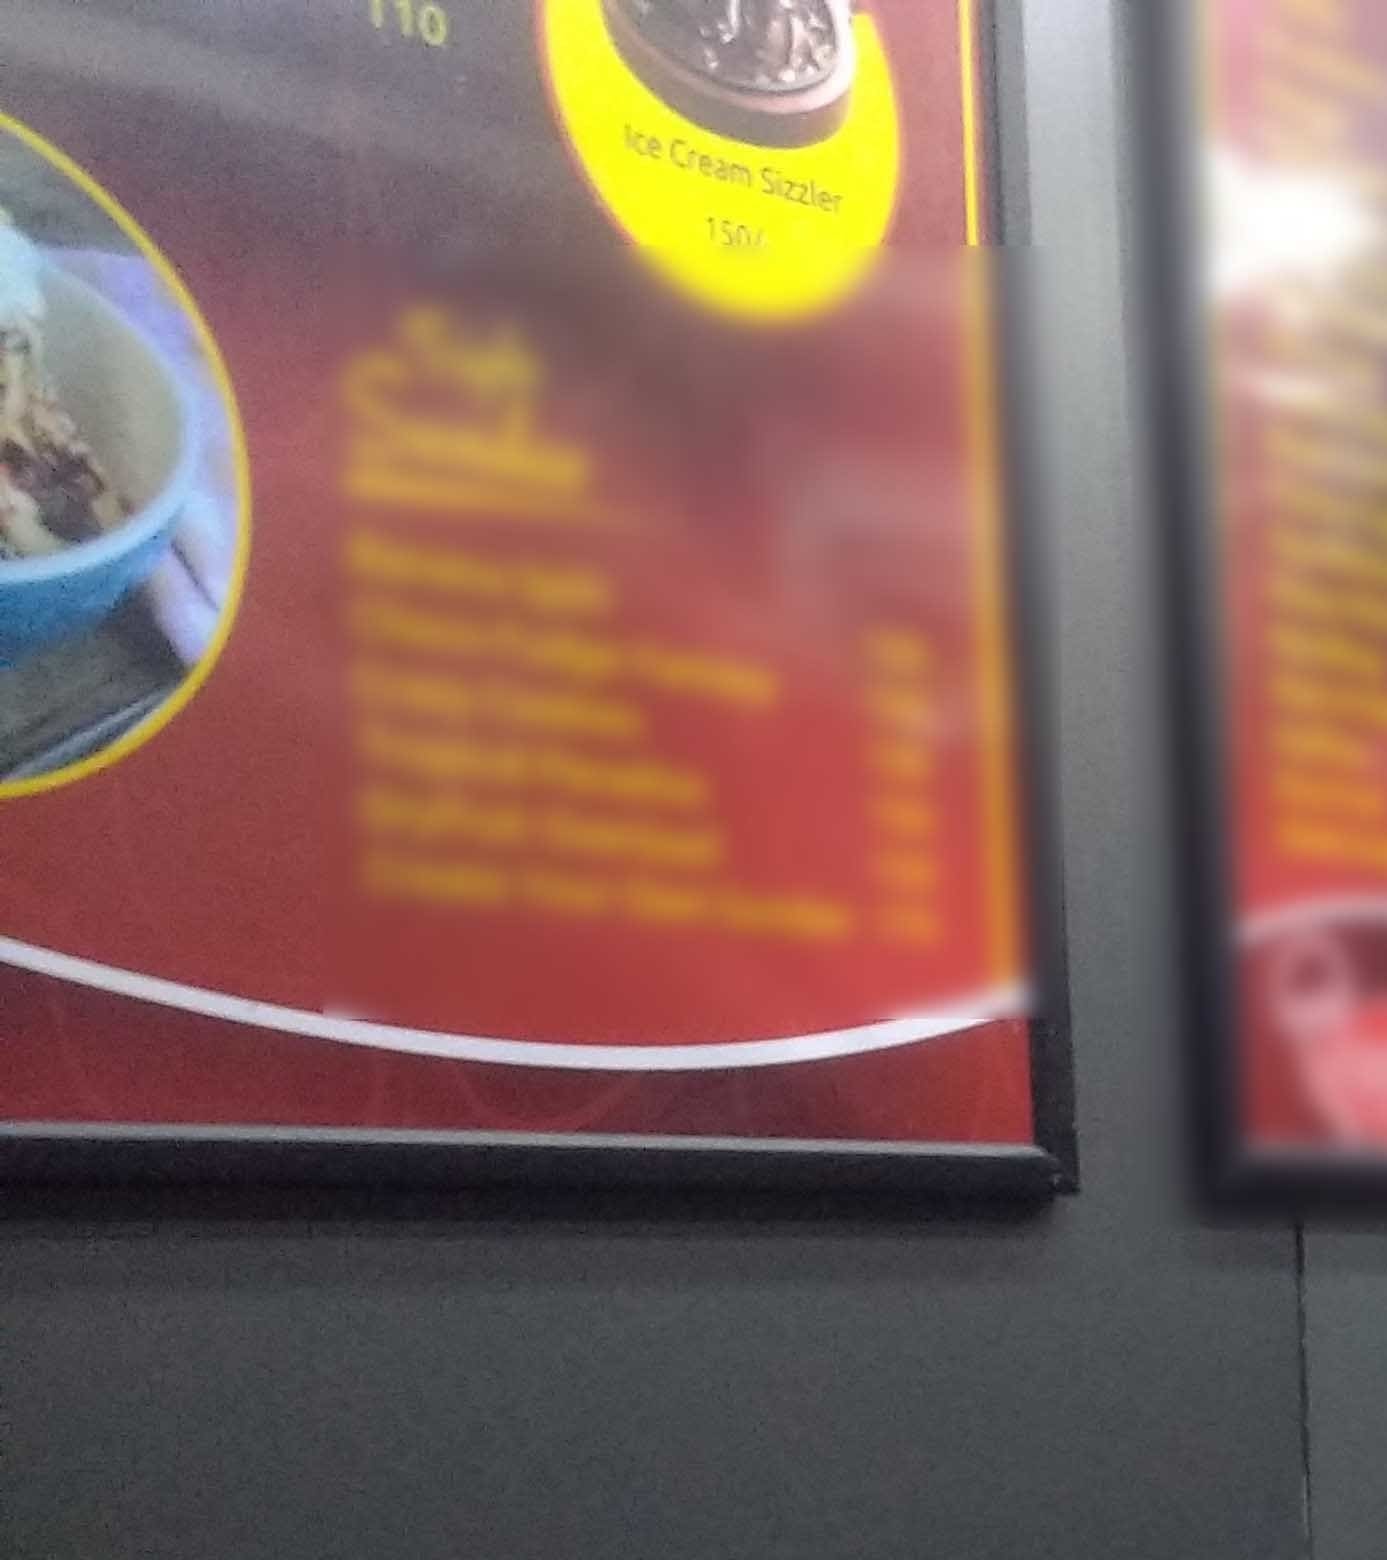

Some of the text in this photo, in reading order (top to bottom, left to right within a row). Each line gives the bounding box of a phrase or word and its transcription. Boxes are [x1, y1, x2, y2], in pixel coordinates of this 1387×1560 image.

[623, 122, 844, 213] Ice Cream Sizzler
